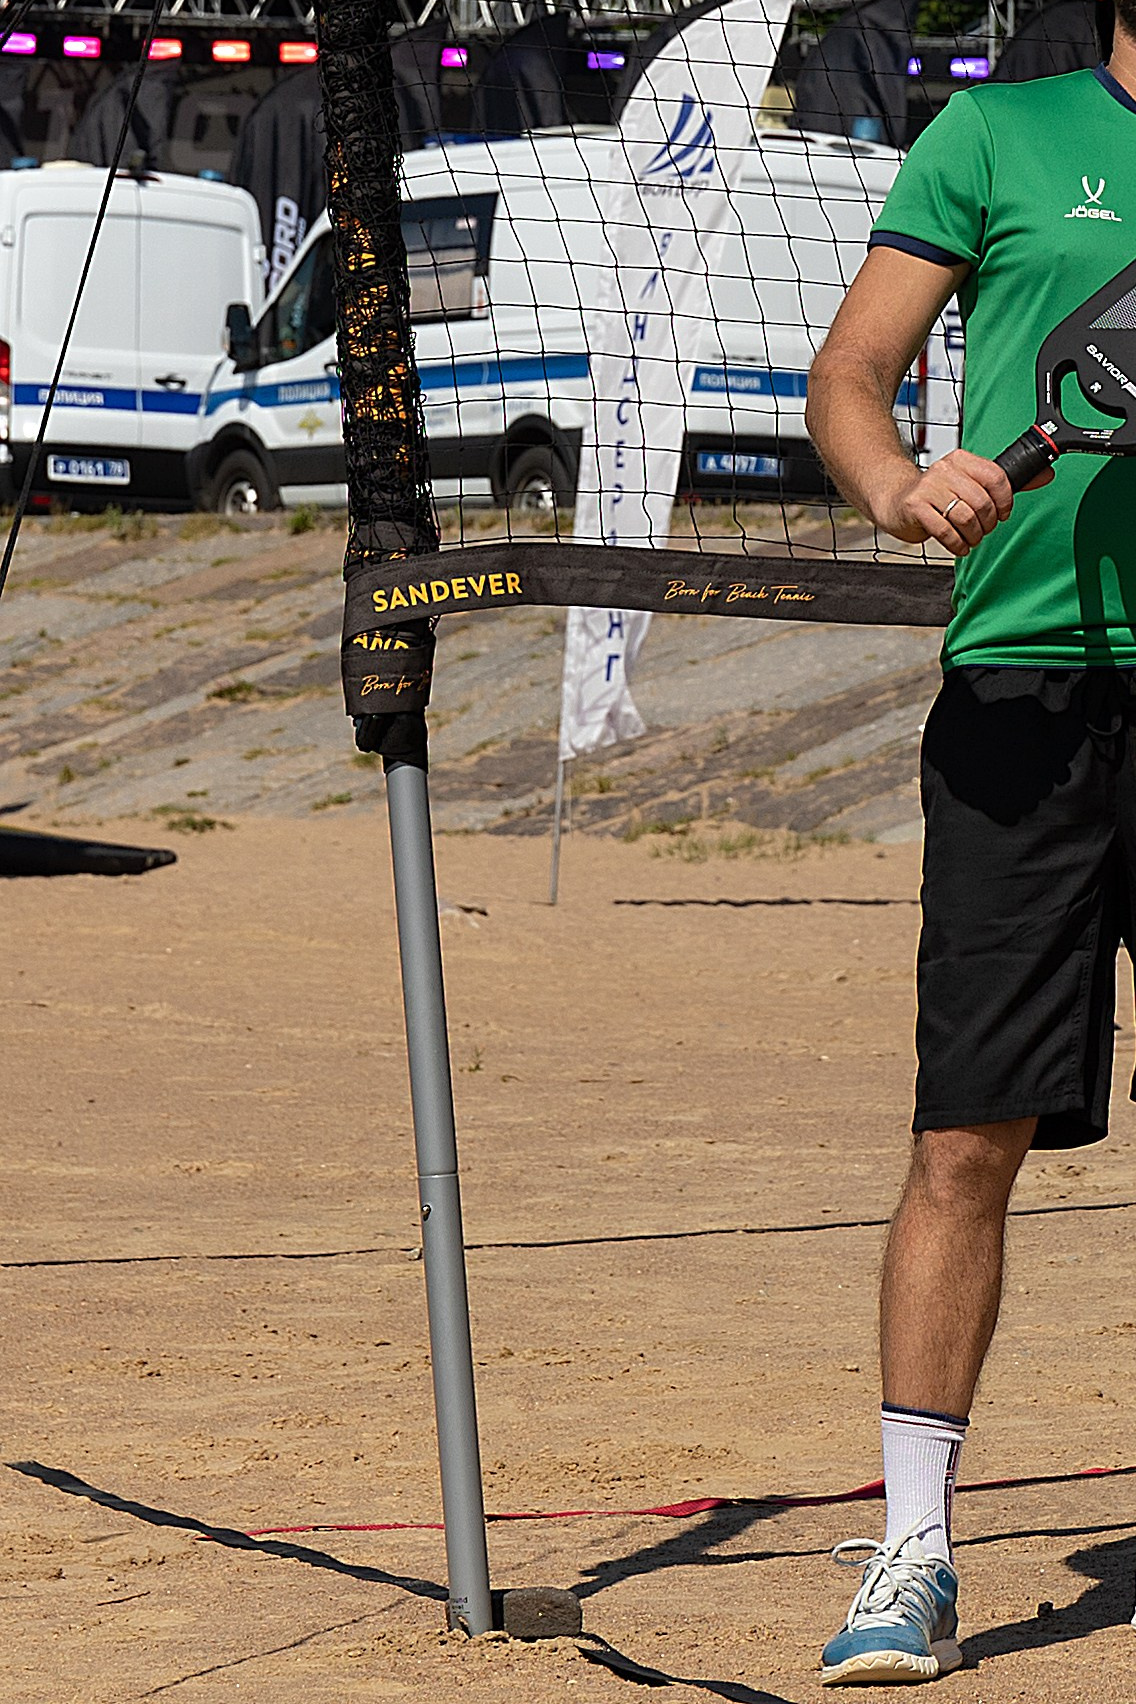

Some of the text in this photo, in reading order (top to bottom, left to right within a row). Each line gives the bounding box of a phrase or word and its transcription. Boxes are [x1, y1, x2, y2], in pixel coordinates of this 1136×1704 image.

[1063, 204, 1123, 223] JÖGEL
[1086, 344, 1129, 385] SAVIOR
[372, 572, 523, 613] SANDEVER
[664, 580, 815, 605] Born for Beach Tennis
[360, 674, 395, 696] Born
[395, 675, 415, 696] for
